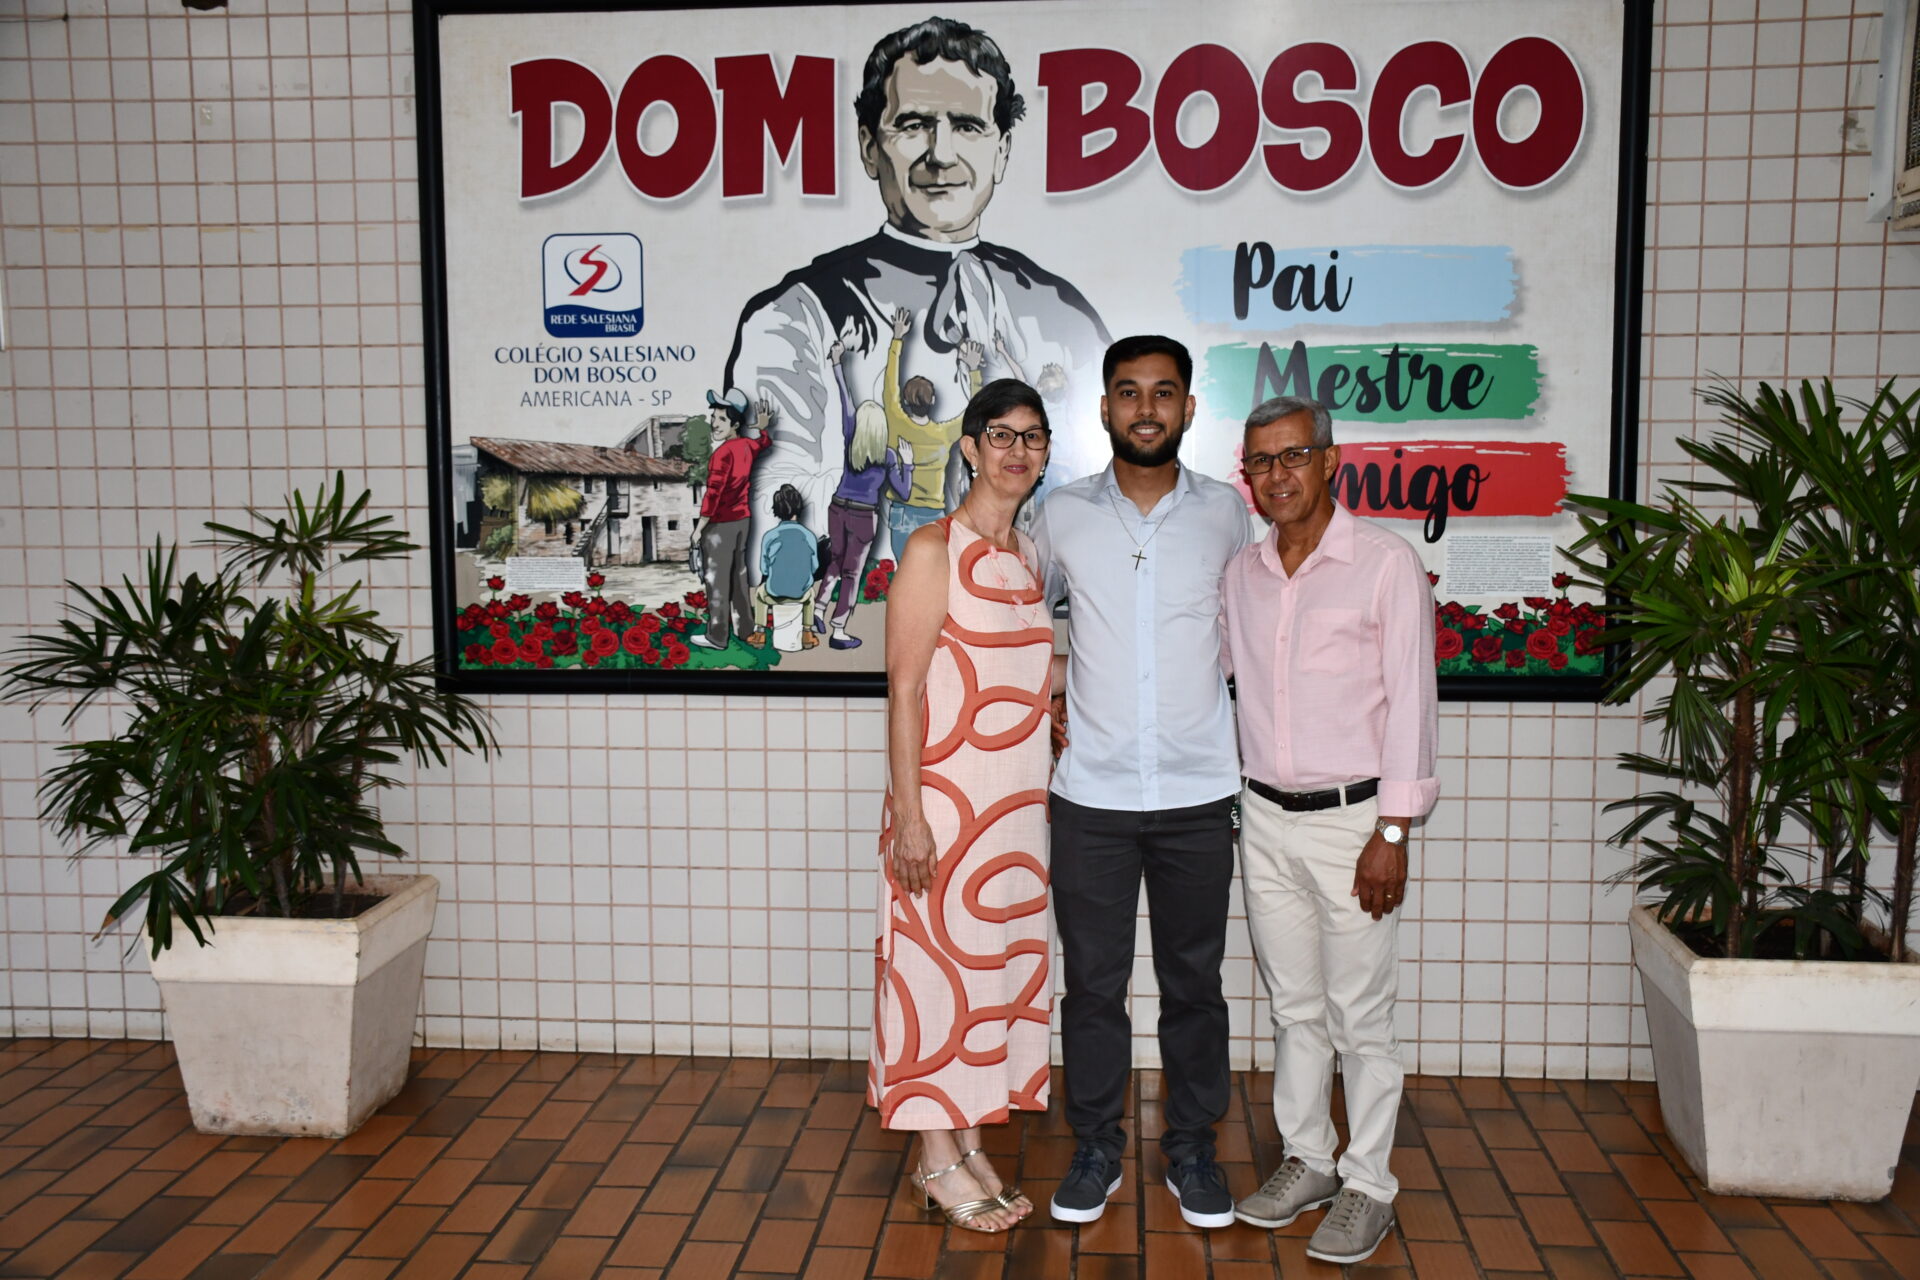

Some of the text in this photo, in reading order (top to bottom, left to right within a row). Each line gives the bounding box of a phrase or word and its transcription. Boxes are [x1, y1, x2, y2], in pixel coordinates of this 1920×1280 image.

[510, 35, 1587, 199] DOM BOSCO
[1233, 241, 1353, 320] Pai
[550, 314, 637, 325] REDE SALESIANA
[605, 324, 636, 333] BRASIL
[495, 342, 696, 364] COLÉGIO SALESIANO
[534, 366, 657, 383] DOM BOSCO
[1253, 339, 1494, 414] Mestre
[519, 391, 632, 407] AMERICANA
[651, 390, 672, 406] SP
[1330, 449, 1491, 544] migo
